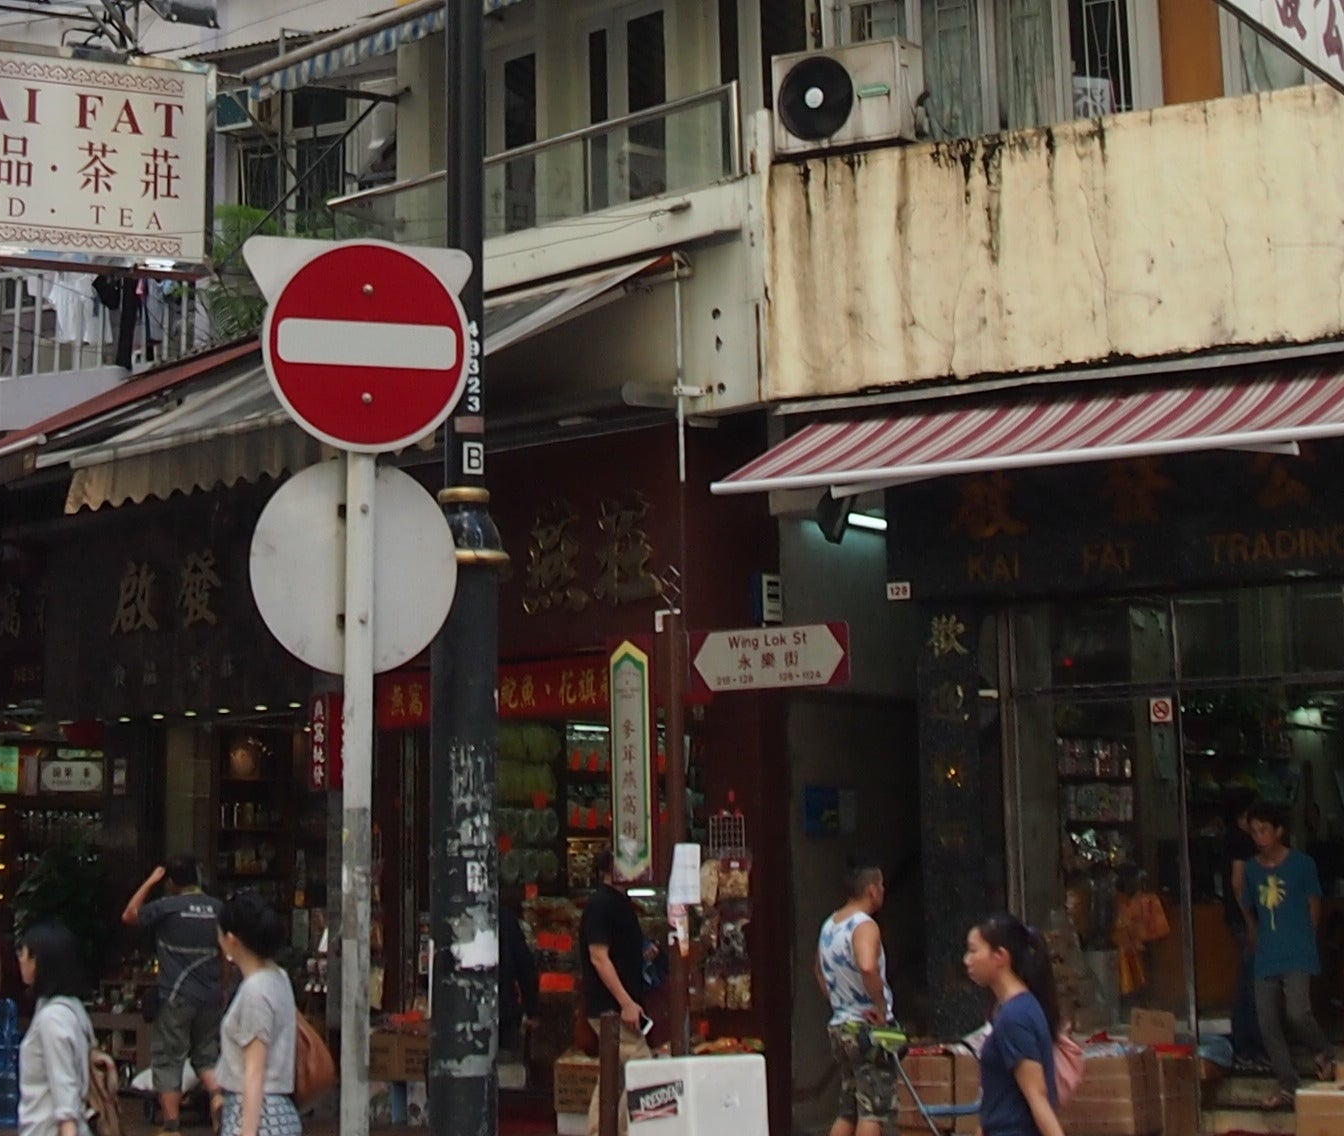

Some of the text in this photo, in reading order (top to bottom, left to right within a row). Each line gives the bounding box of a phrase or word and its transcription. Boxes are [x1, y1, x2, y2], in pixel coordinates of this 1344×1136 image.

[75, 92, 185, 140] FAT
[90, 204, 164, 232] TEA
[467, 446, 482, 470] B
[965, 549, 1022, 584] KAI
[728, 631, 808, 650] Wing Lok St
[737, 650, 800, 672] 永樂街
